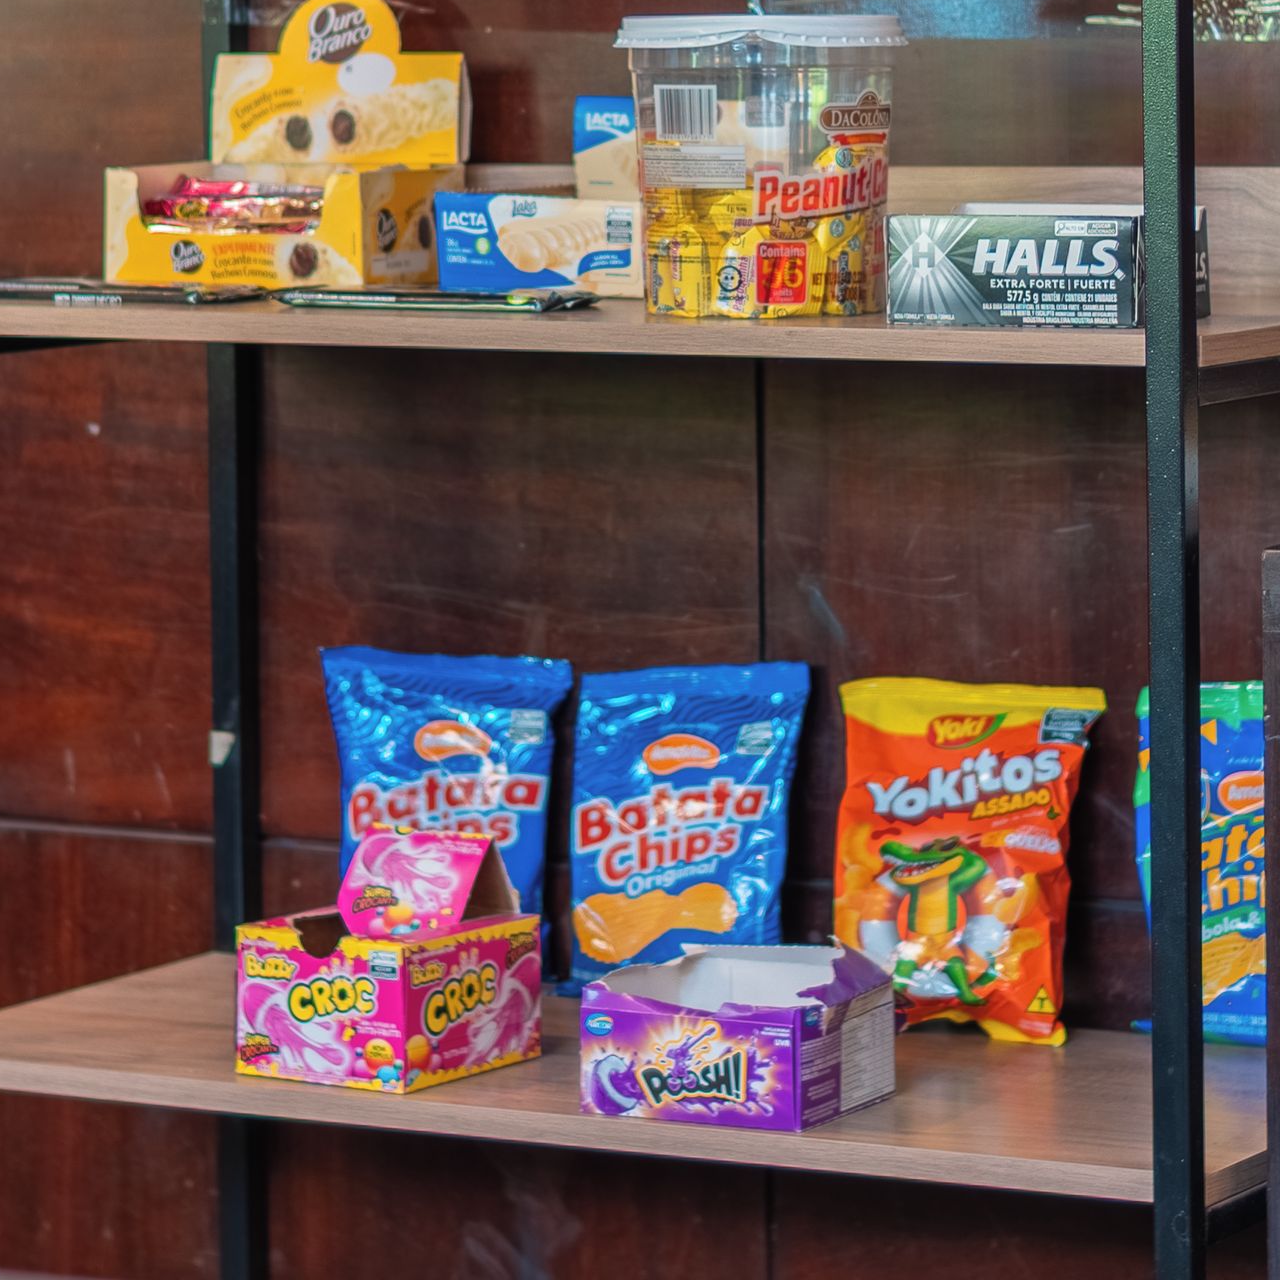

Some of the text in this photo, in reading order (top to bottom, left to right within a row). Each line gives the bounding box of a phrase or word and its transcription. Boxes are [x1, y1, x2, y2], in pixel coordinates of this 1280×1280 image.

[309, 4, 365, 39] Ouro
[307, 22, 373, 65] Branco
[585, 112, 630, 132] LACTA
[757, 166, 868, 218] Peanut
[443, 211, 488, 232] LACTA
[512, 200, 538, 218] Laka
[170, 239, 199, 261] Ouro
[172, 252, 205, 273] Branco
[213, 255, 252, 268] Crocante
[760, 245, 806, 258] Contains
[972, 238, 1121, 277] HALLS
[990, 278, 1117, 290] EXTRA FORTE FUERTE
[1006, 290, 1032, 303] 577,5
[1032, 292, 1039, 304] g
[577, 780, 766, 851] Batata
[970, 788, 1052, 819] ASSADO
[602, 824, 739, 883] Chips
[1003, 833, 1061, 854] QUEIJO
[627, 860, 718, 896] Original
[288, 975, 377, 1024] CROC
[424, 962, 498, 1038] CROC
